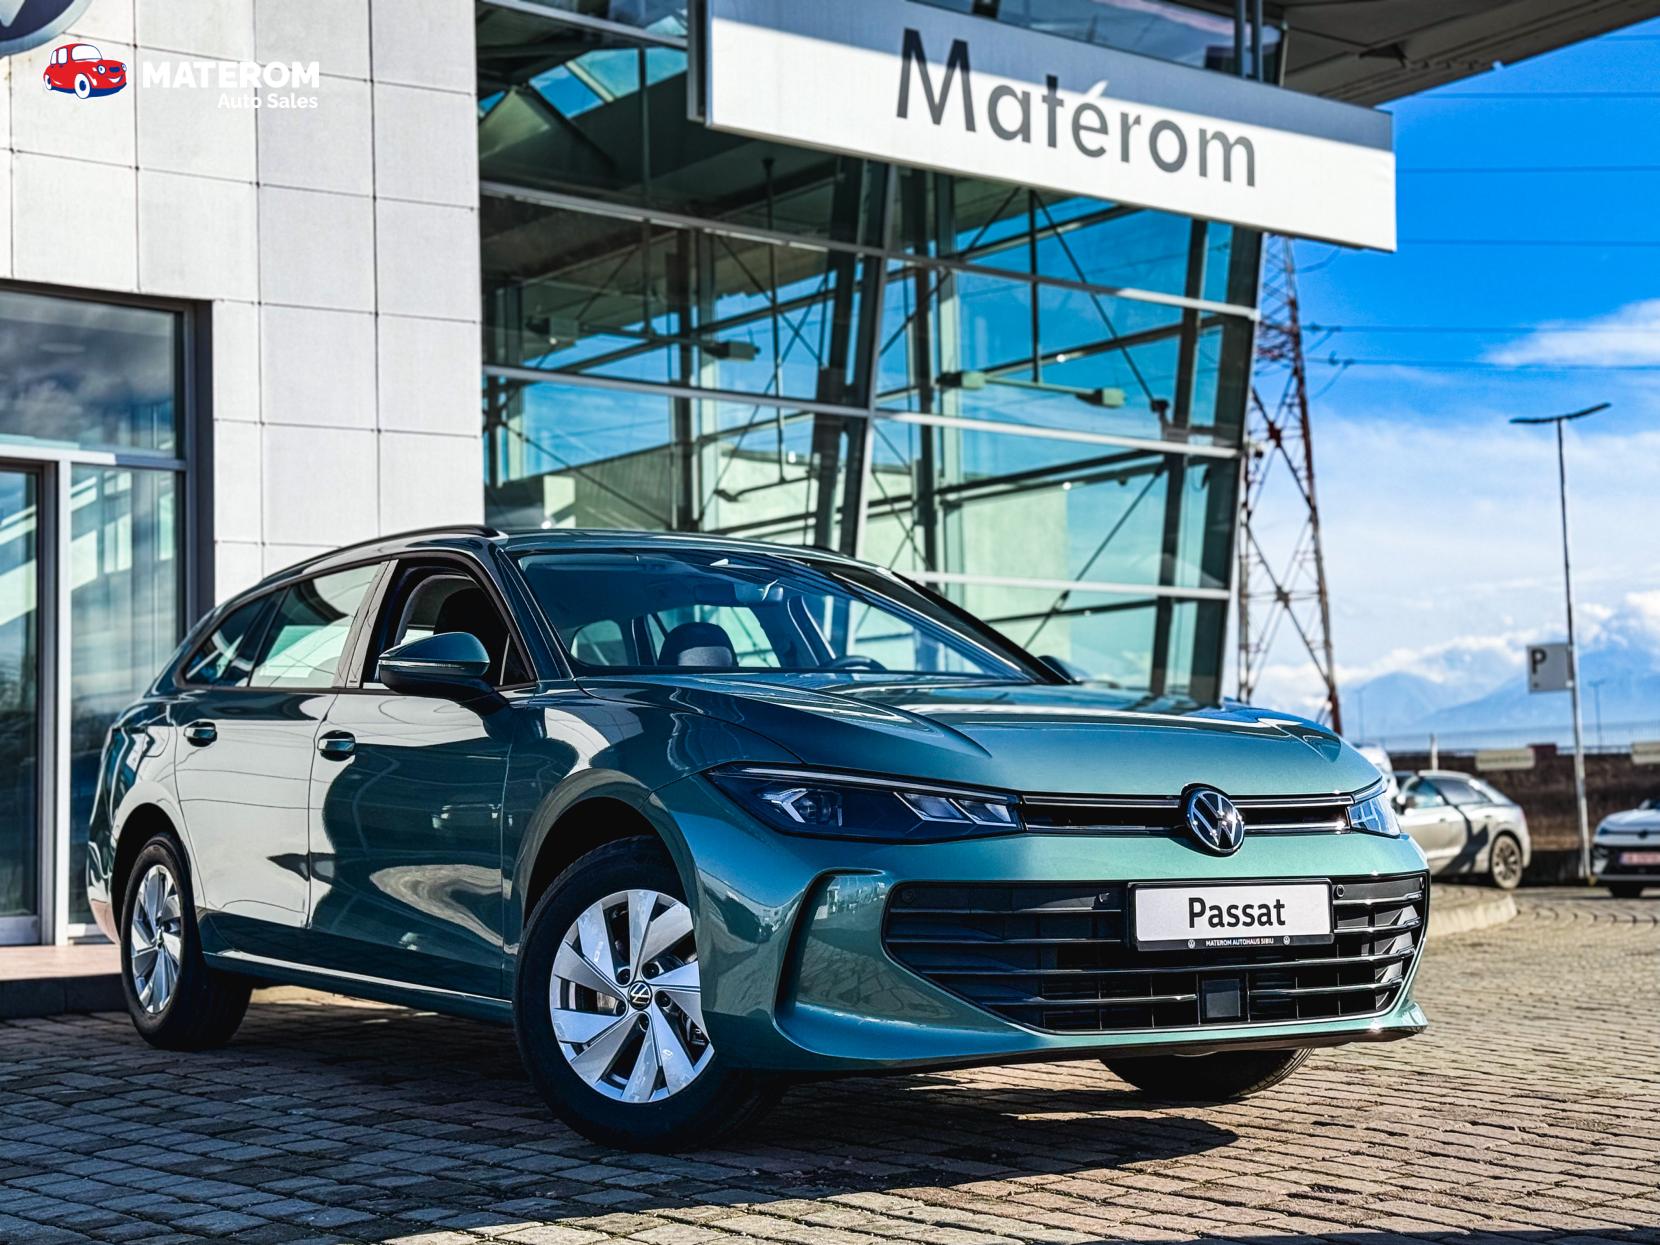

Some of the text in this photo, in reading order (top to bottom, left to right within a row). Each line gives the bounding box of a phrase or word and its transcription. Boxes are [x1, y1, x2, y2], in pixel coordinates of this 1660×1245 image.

[896, 27, 1255, 188] Matérom
[1531, 648, 1547, 675] P
[1188, 897, 1286, 929] Passat
